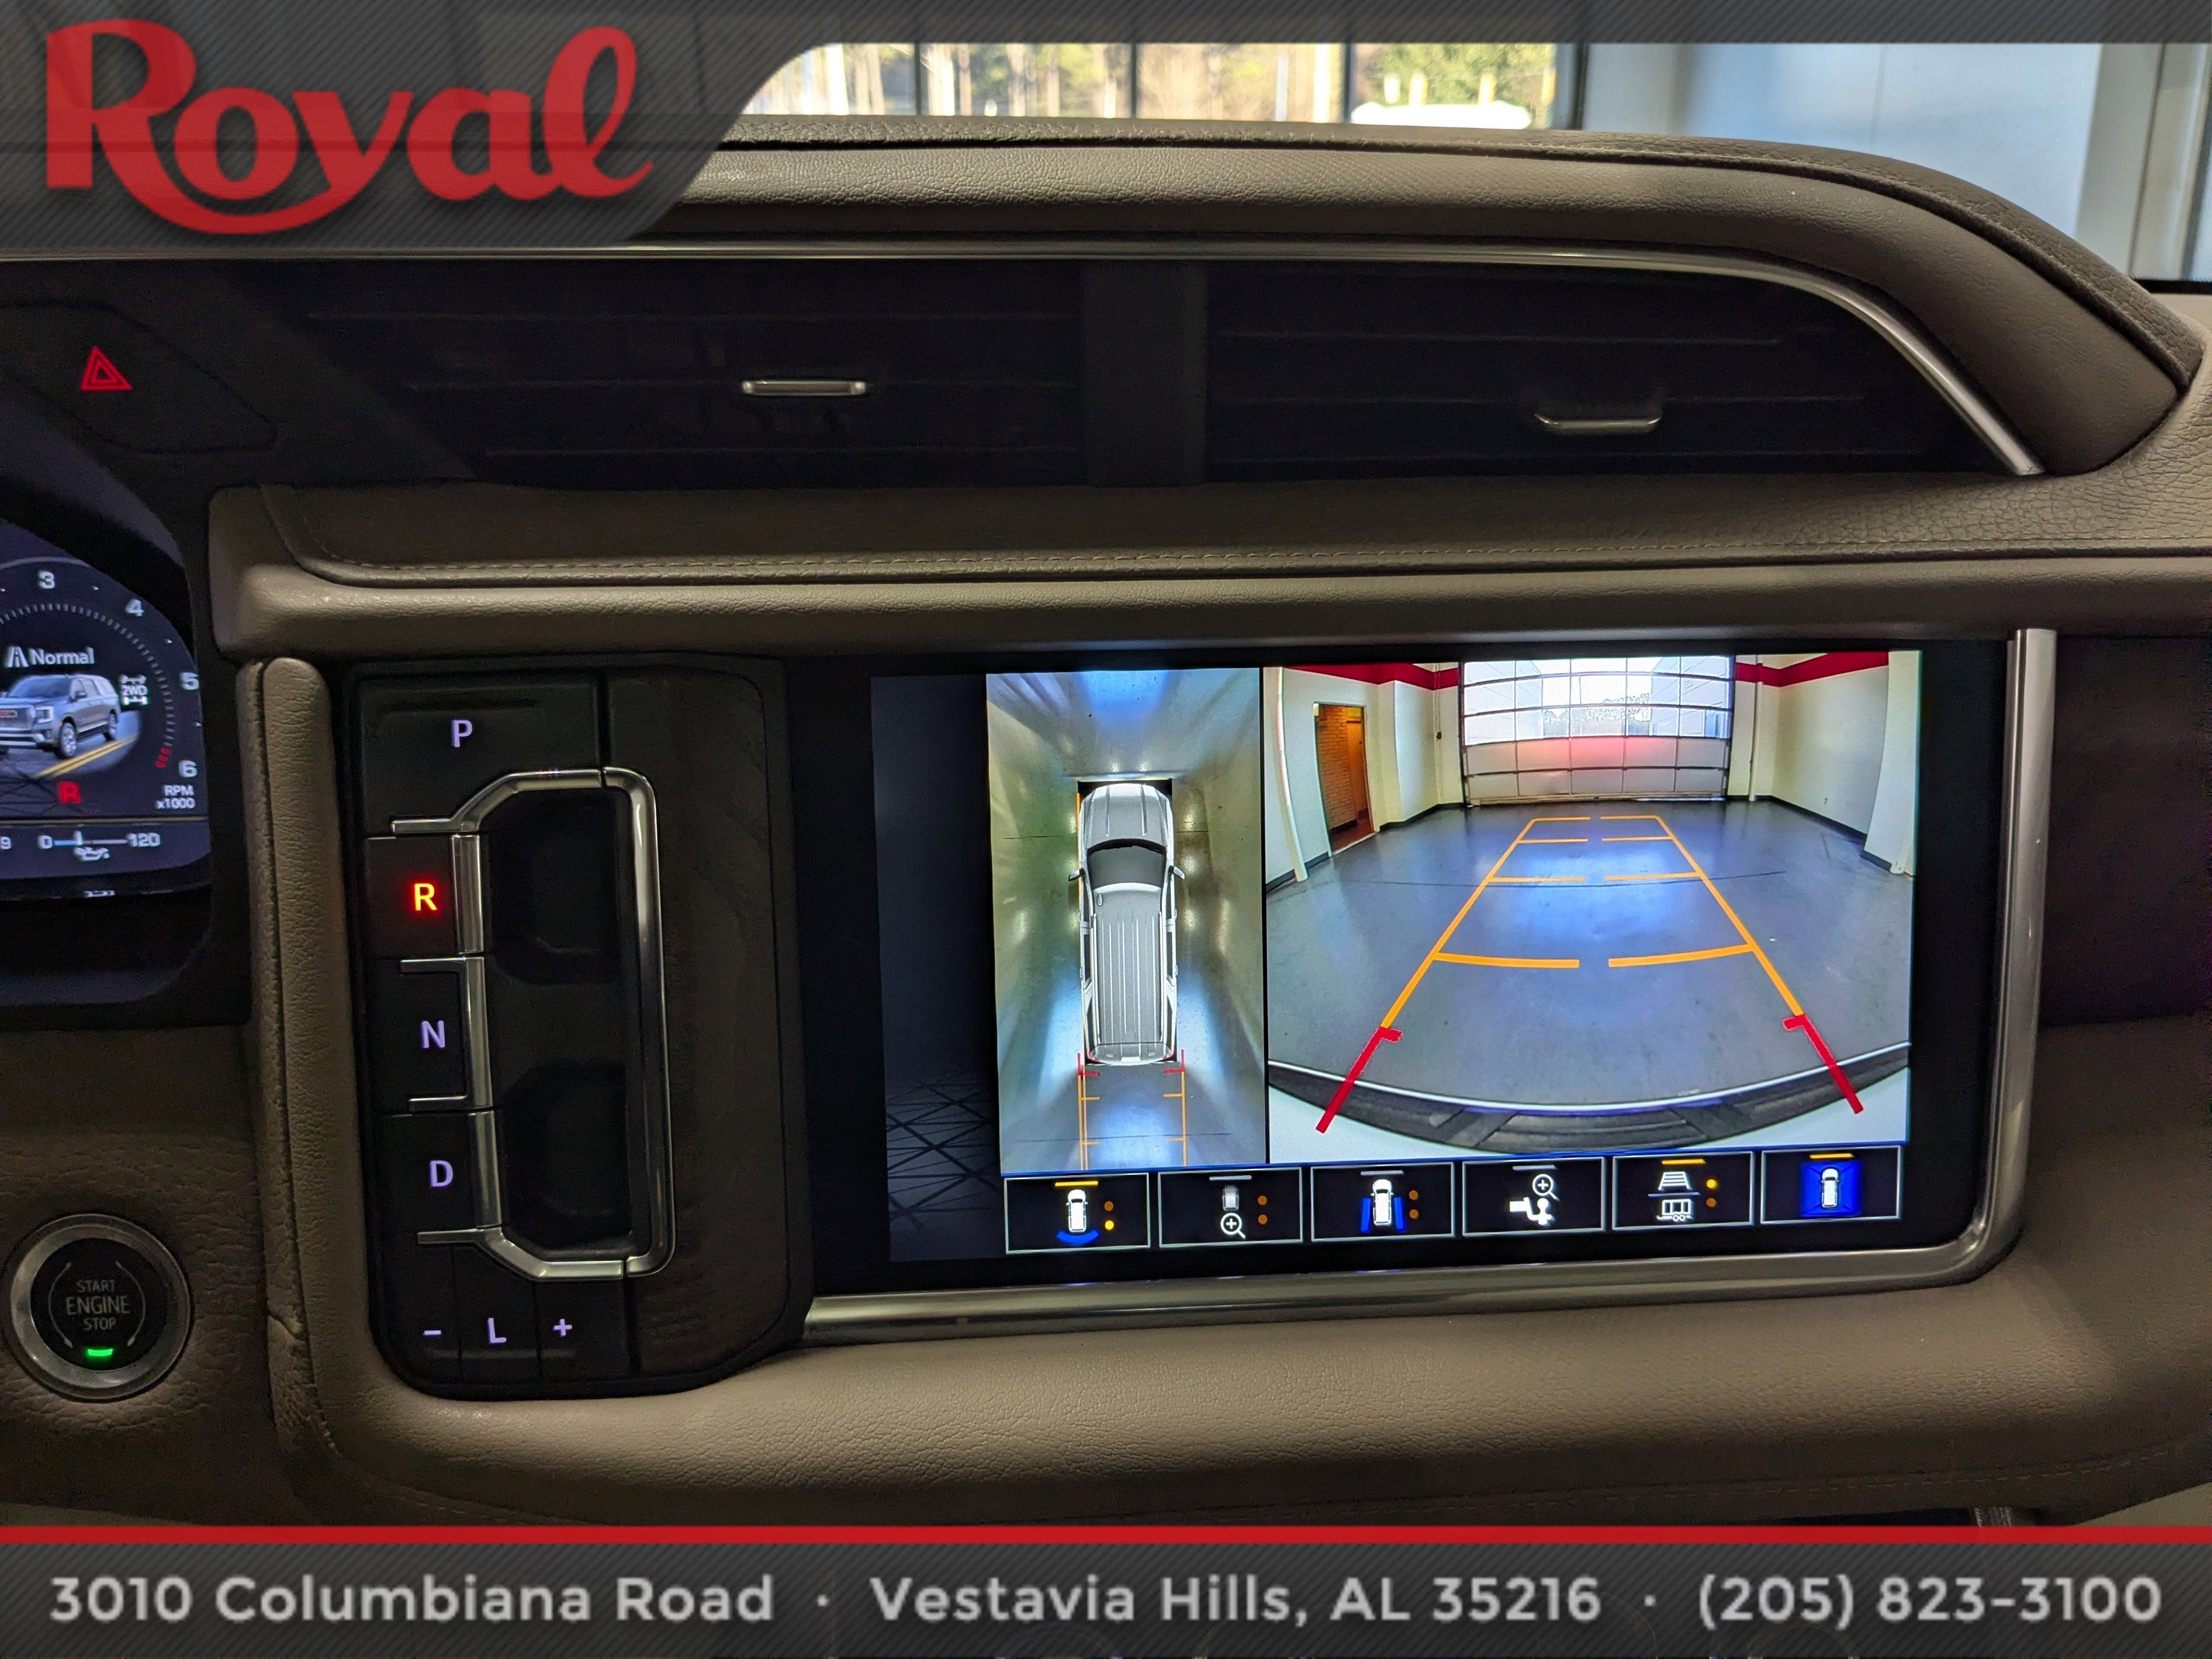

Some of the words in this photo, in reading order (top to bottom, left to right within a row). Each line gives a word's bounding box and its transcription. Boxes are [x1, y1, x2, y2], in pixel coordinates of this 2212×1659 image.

[38, 571, 56, 590] 3
[126, 599, 144, 617] 4
[30, 646, 95, 667] Normal
[180, 672, 200, 691] 5
[451, 719, 473, 748] P
[178, 760, 198, 778] 6
[58, 781, 81, 804] R
[164, 784, 195, 797] RPM
[156, 797, 196, 810] x1000
[38, 834, 53, 850] 0
[127, 832, 161, 848] 120
[410, 881, 440, 913] R
[420, 1019, 446, 1049] N
[429, 1159, 454, 1188] D
[76, 1279, 116, 1294] START
[65, 1294, 131, 1316] ENGINE
[82, 1316, 117, 1332] STOP
[486, 1317, 507, 1345] L
